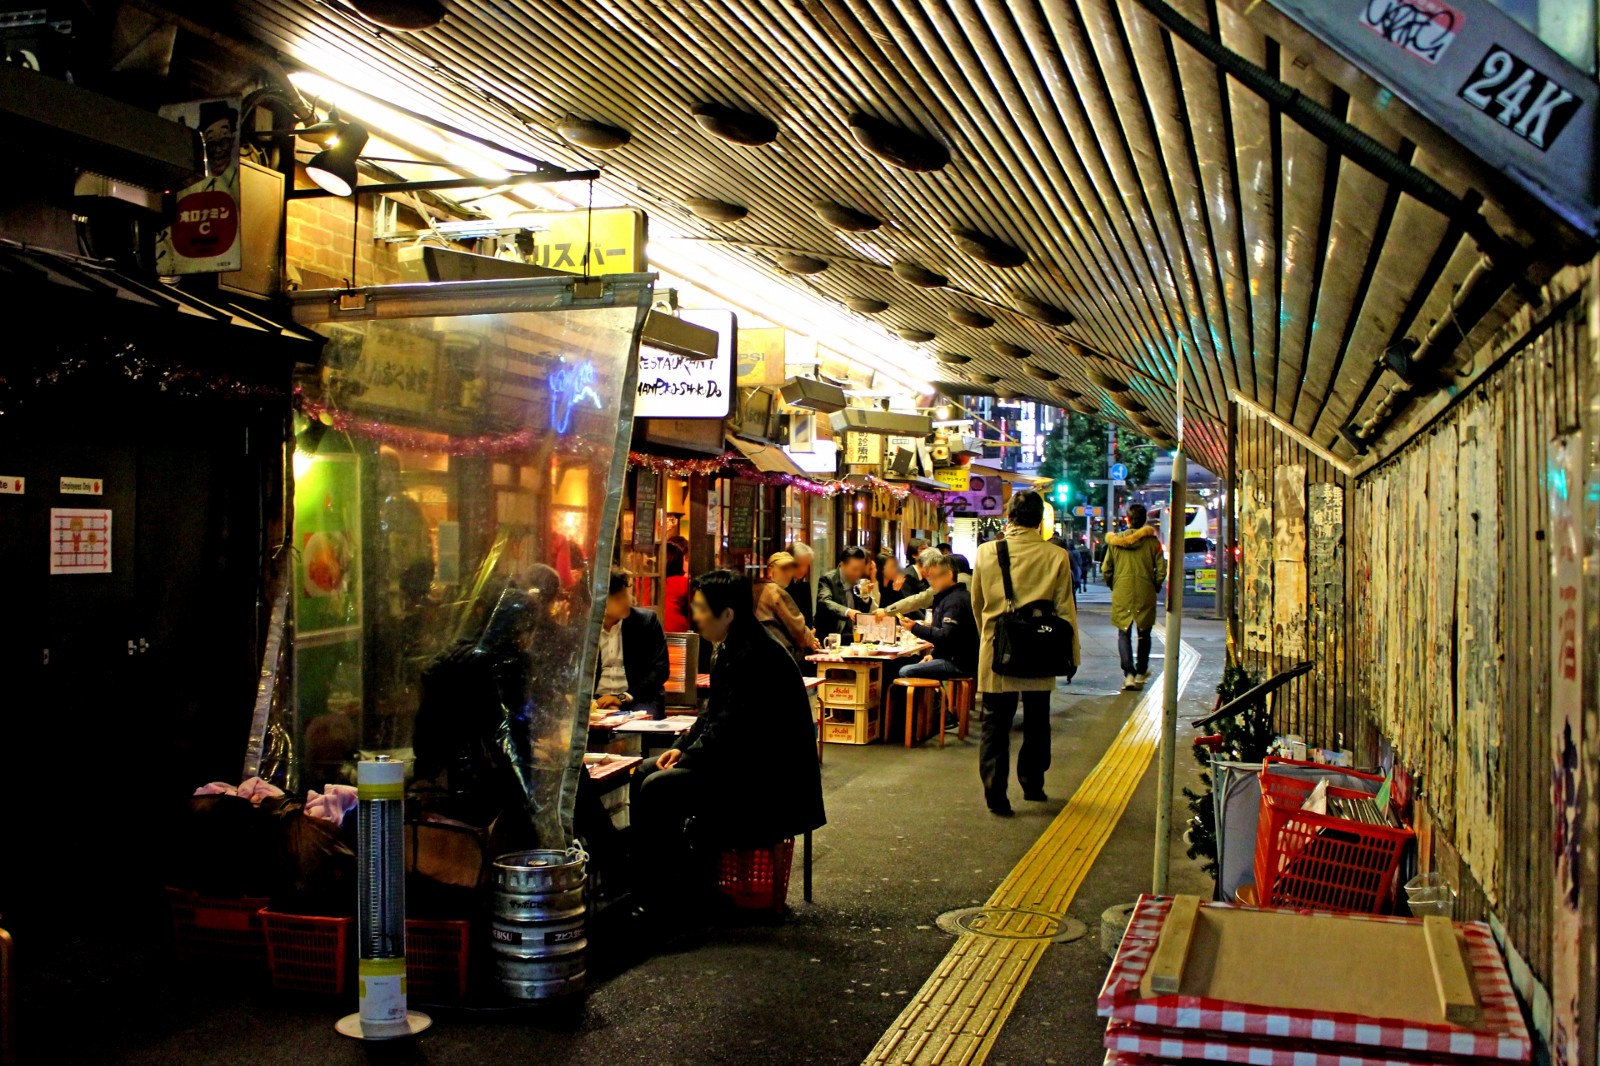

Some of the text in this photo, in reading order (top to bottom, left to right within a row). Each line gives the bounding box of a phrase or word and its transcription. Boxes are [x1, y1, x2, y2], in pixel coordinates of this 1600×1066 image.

[1463, 51, 1573, 149] 24K
[180, 207, 229, 222] オロナミン
[199, 222, 210, 234] C
[61, 481, 91, 492] Employees Only
